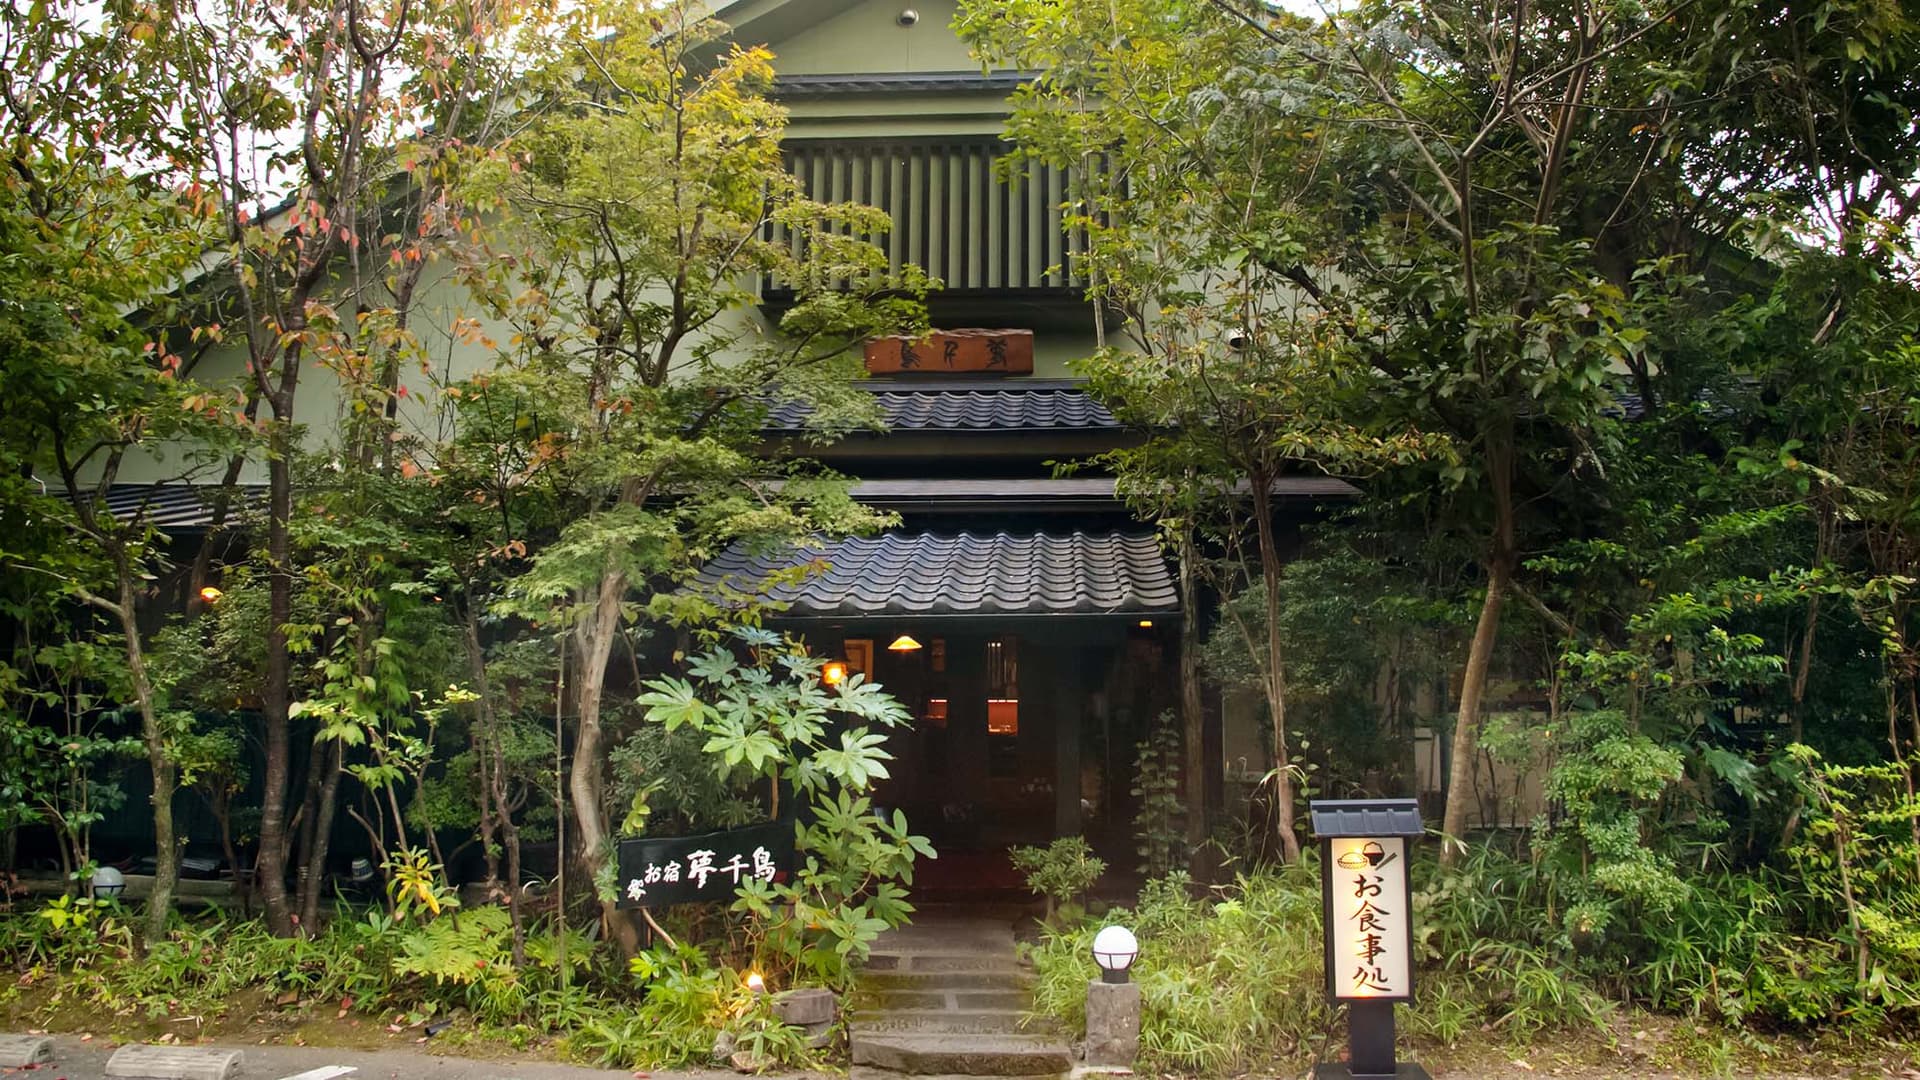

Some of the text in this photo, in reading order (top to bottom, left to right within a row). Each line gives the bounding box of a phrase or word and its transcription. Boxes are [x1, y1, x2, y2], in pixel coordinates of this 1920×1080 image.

[644, 846, 776, 889] お宿 夢千鳥
[1350, 873, 1392, 992] お食事処
